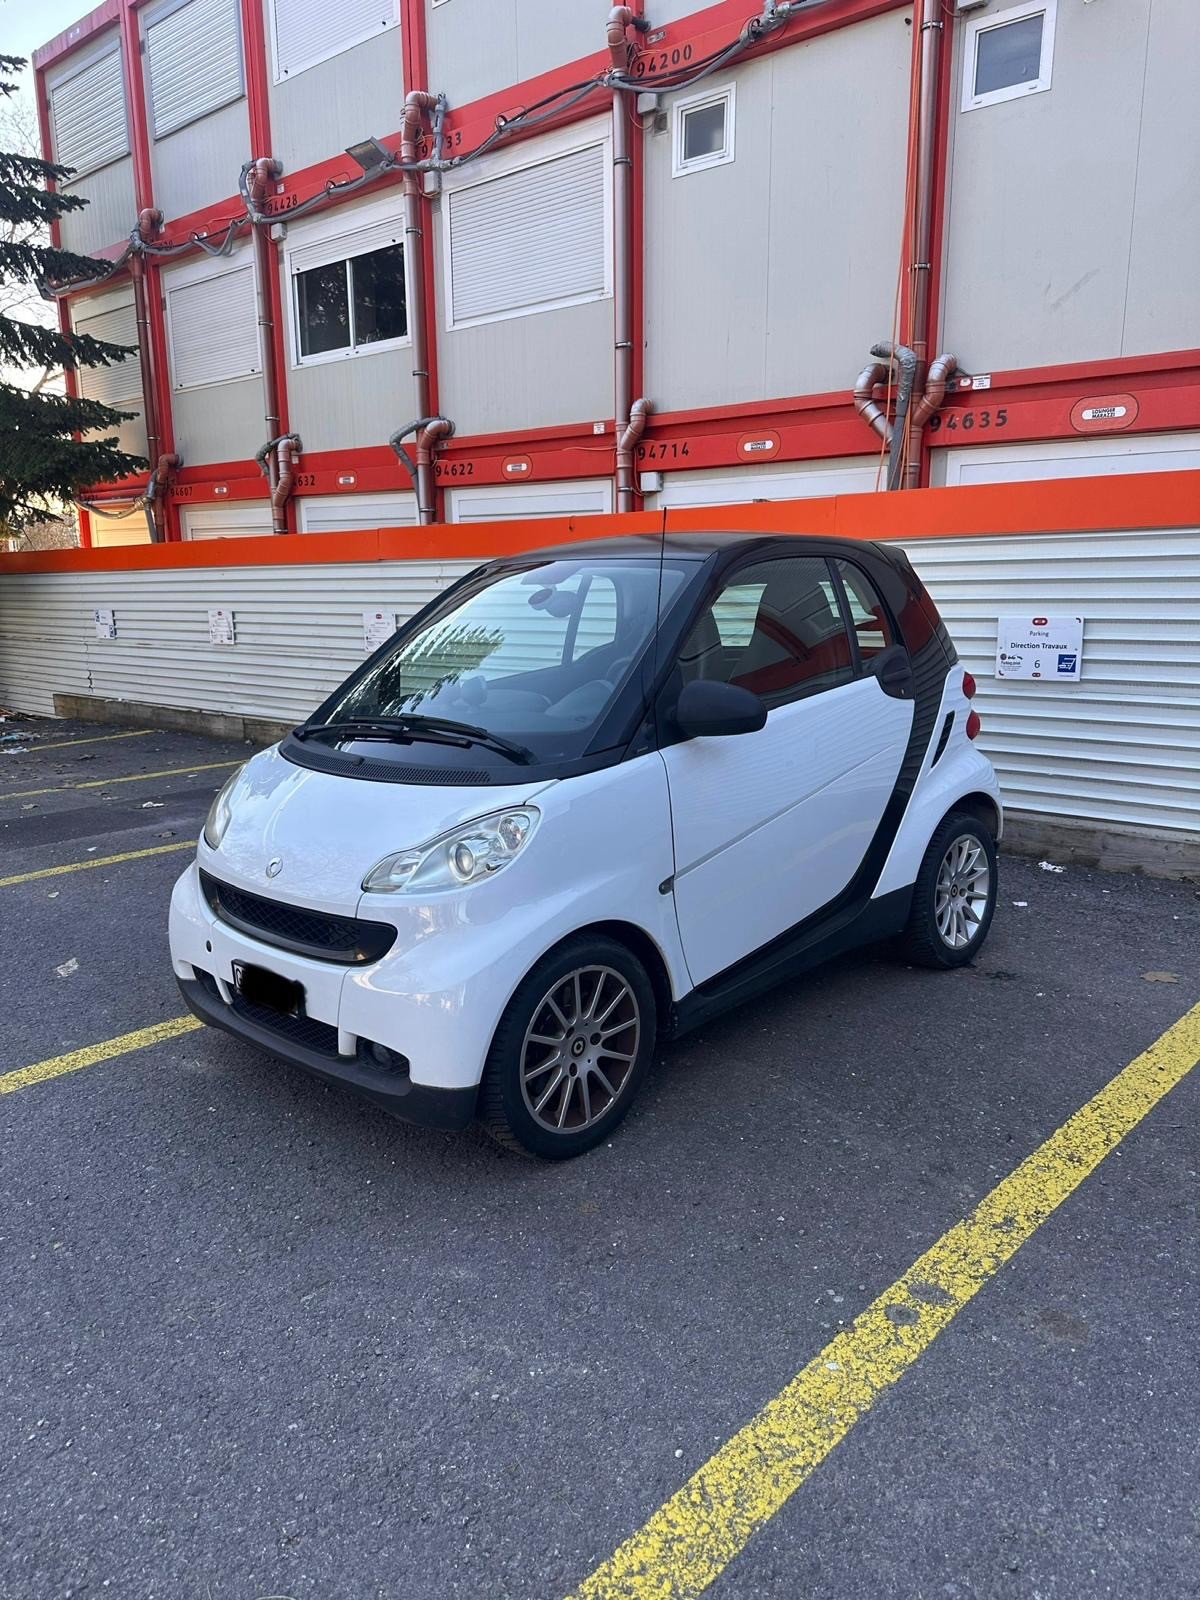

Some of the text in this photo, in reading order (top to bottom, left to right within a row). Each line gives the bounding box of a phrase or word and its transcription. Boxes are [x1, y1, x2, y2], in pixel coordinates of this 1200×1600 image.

[636, 44, 692, 78] 94200
[422, 131, 461, 158] 933
[268, 194, 297, 215] 94428
[930, 409, 1008, 432] 94635
[638, 442, 689, 460] 94714
[435, 462, 474, 477] 94622
[170, 486, 193, 497] 94607
[1034, 660, 1040, 668] 6
